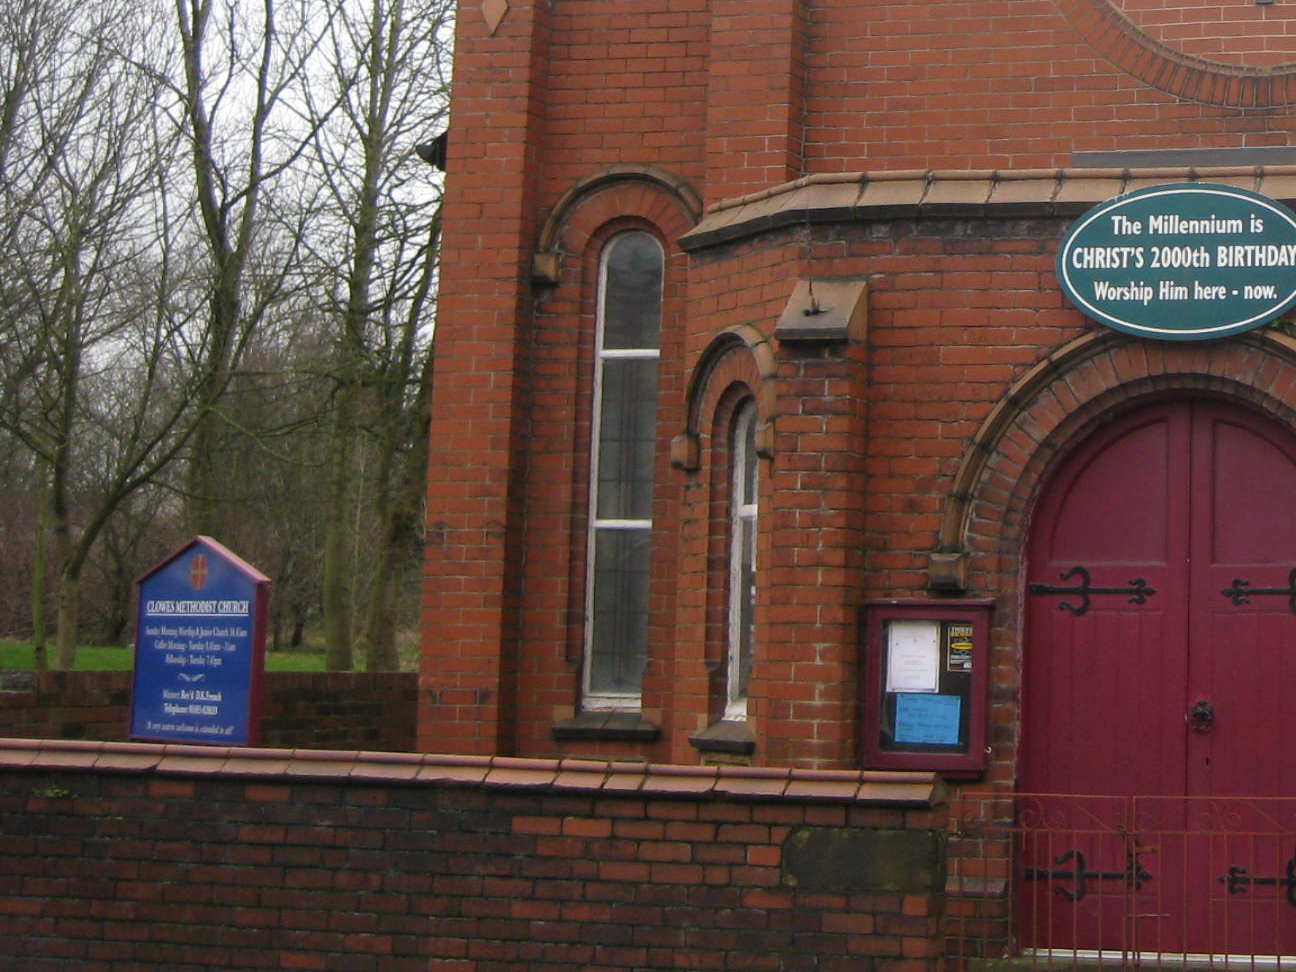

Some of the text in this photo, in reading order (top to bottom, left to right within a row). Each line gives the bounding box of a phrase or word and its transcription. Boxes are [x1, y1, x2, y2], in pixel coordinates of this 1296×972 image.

[1111, 213, 1264, 236] The Millennium is
[1072, 246, 1145, 269] CHRIST'S
[1150, 246, 1210, 268] 2000th
[1094, 280, 1153, 306] Worship
[1159, 280, 1188, 301] Him
[1194, 280, 1227, 300] here
[1244, 283, 1278, 300] now.
[146, 599, 249, 613] CLOWES METHODIST CHURCH
